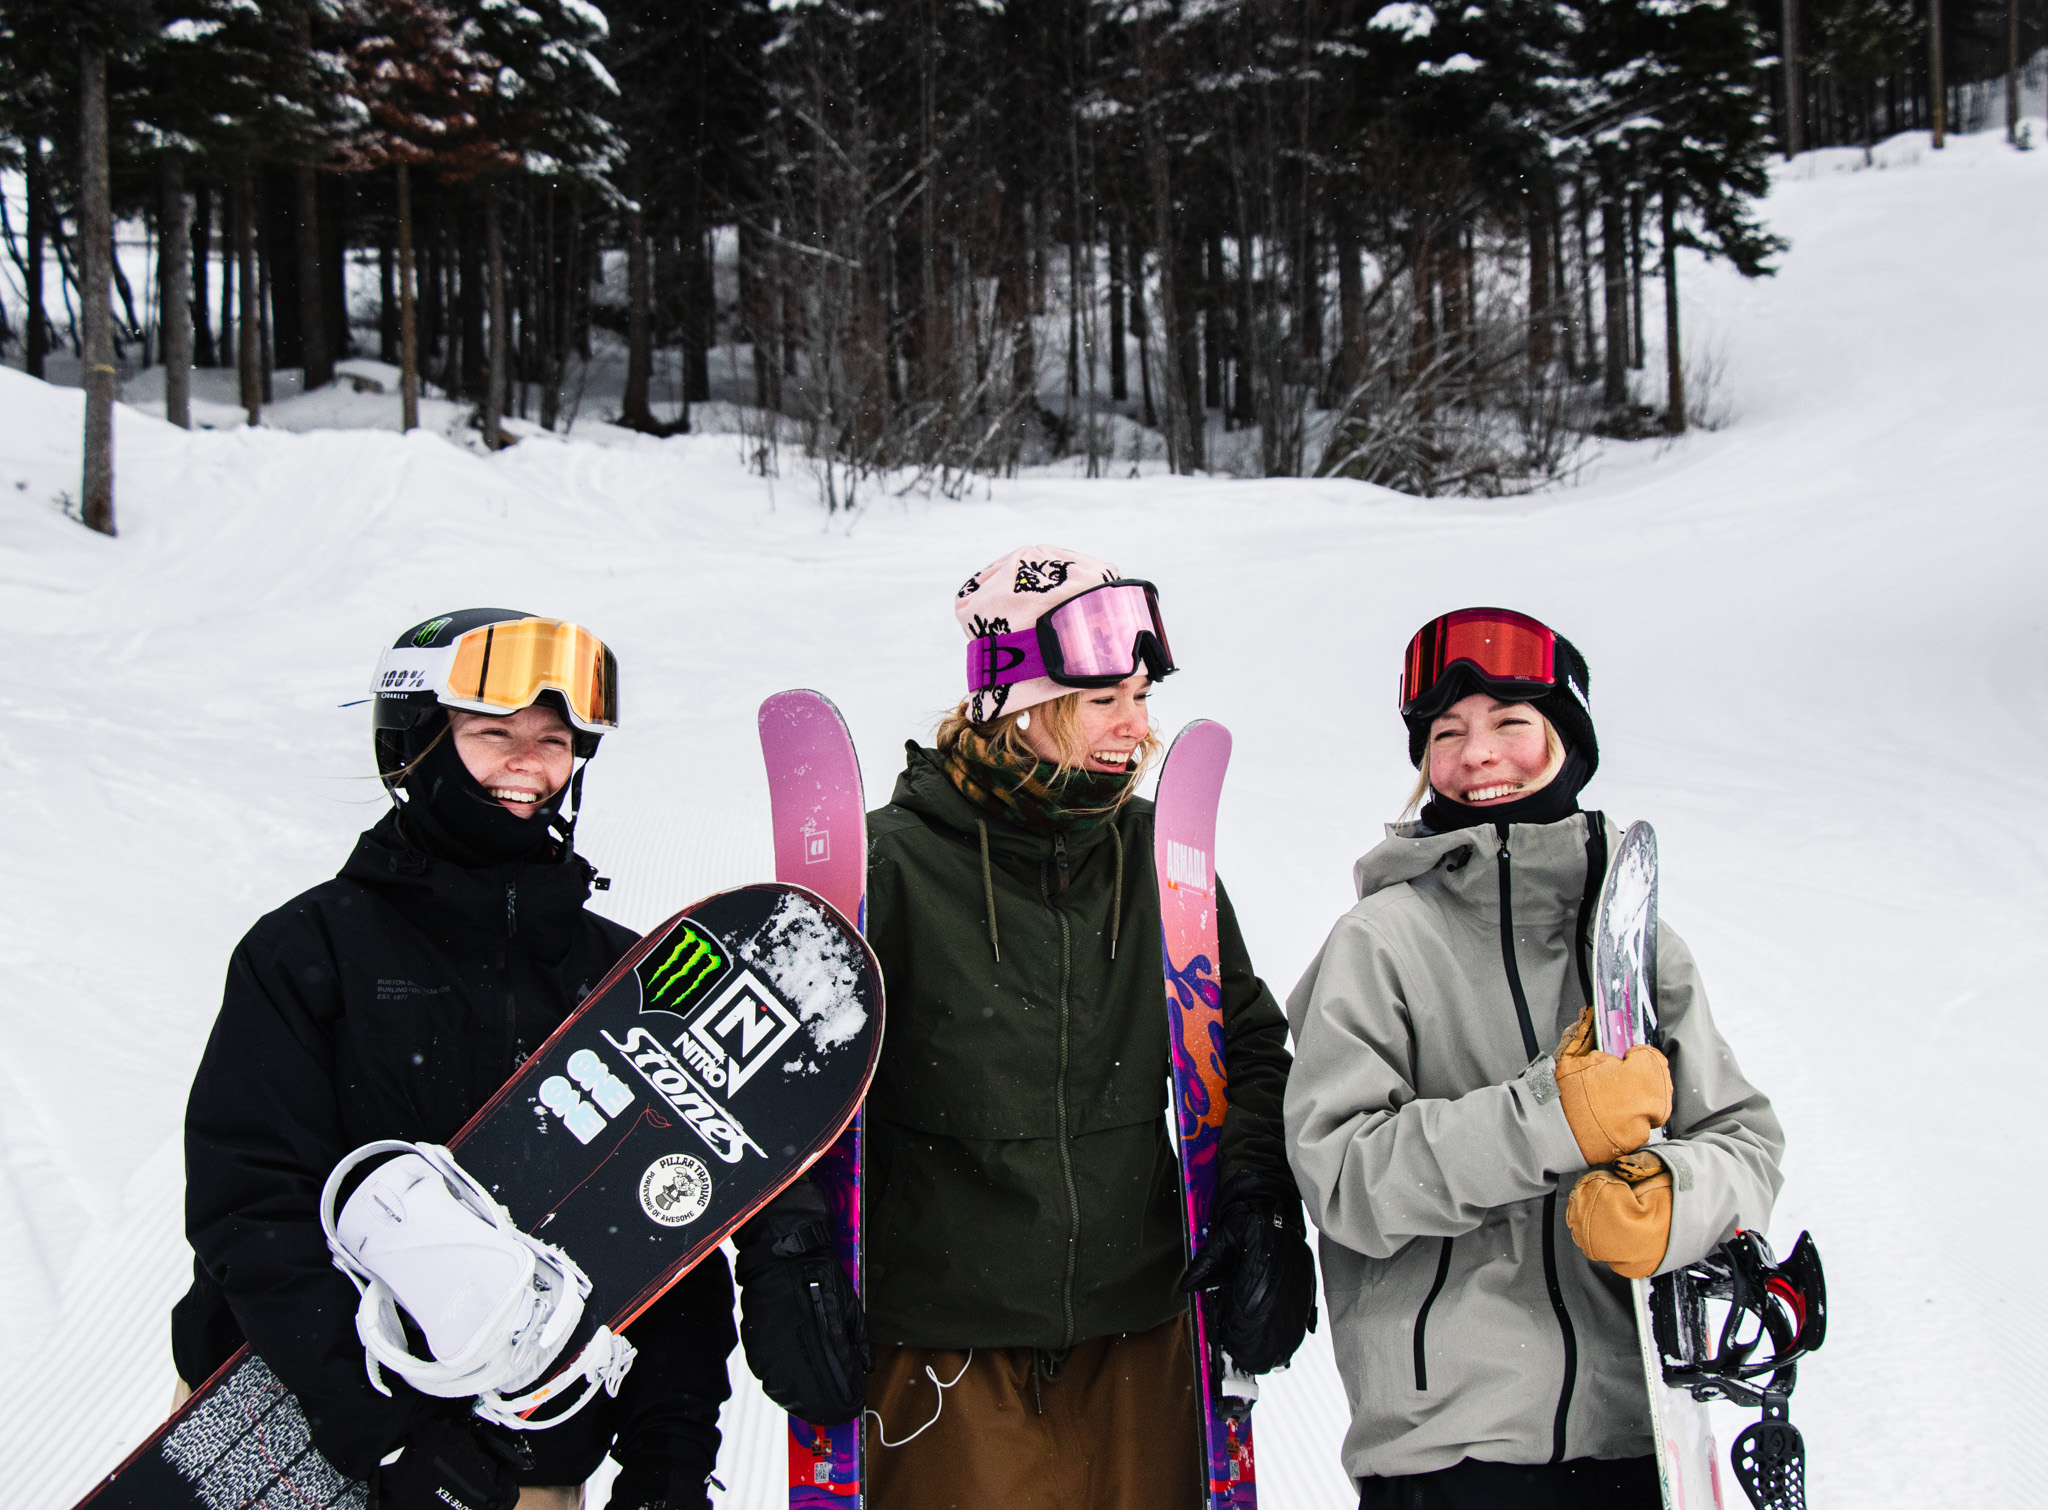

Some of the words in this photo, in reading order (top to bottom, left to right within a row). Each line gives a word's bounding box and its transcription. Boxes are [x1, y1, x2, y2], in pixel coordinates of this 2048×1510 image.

[381, 670, 425, 688] 100%
[381, 692, 409, 700] OAKLEY
[568, 1050, 634, 1117] ONE
[672, 1031, 727, 1088] NITRO
[540, 1077, 606, 1144] ONE
[643, 1171, 656, 1211] PURVEYORS
[651, 1209, 661, 1218] OF
[660, 1210, 695, 1223] AWESOME
[659, 1156, 695, 1169] PILLAR
[694, 1165, 710, 1207] TRADING
